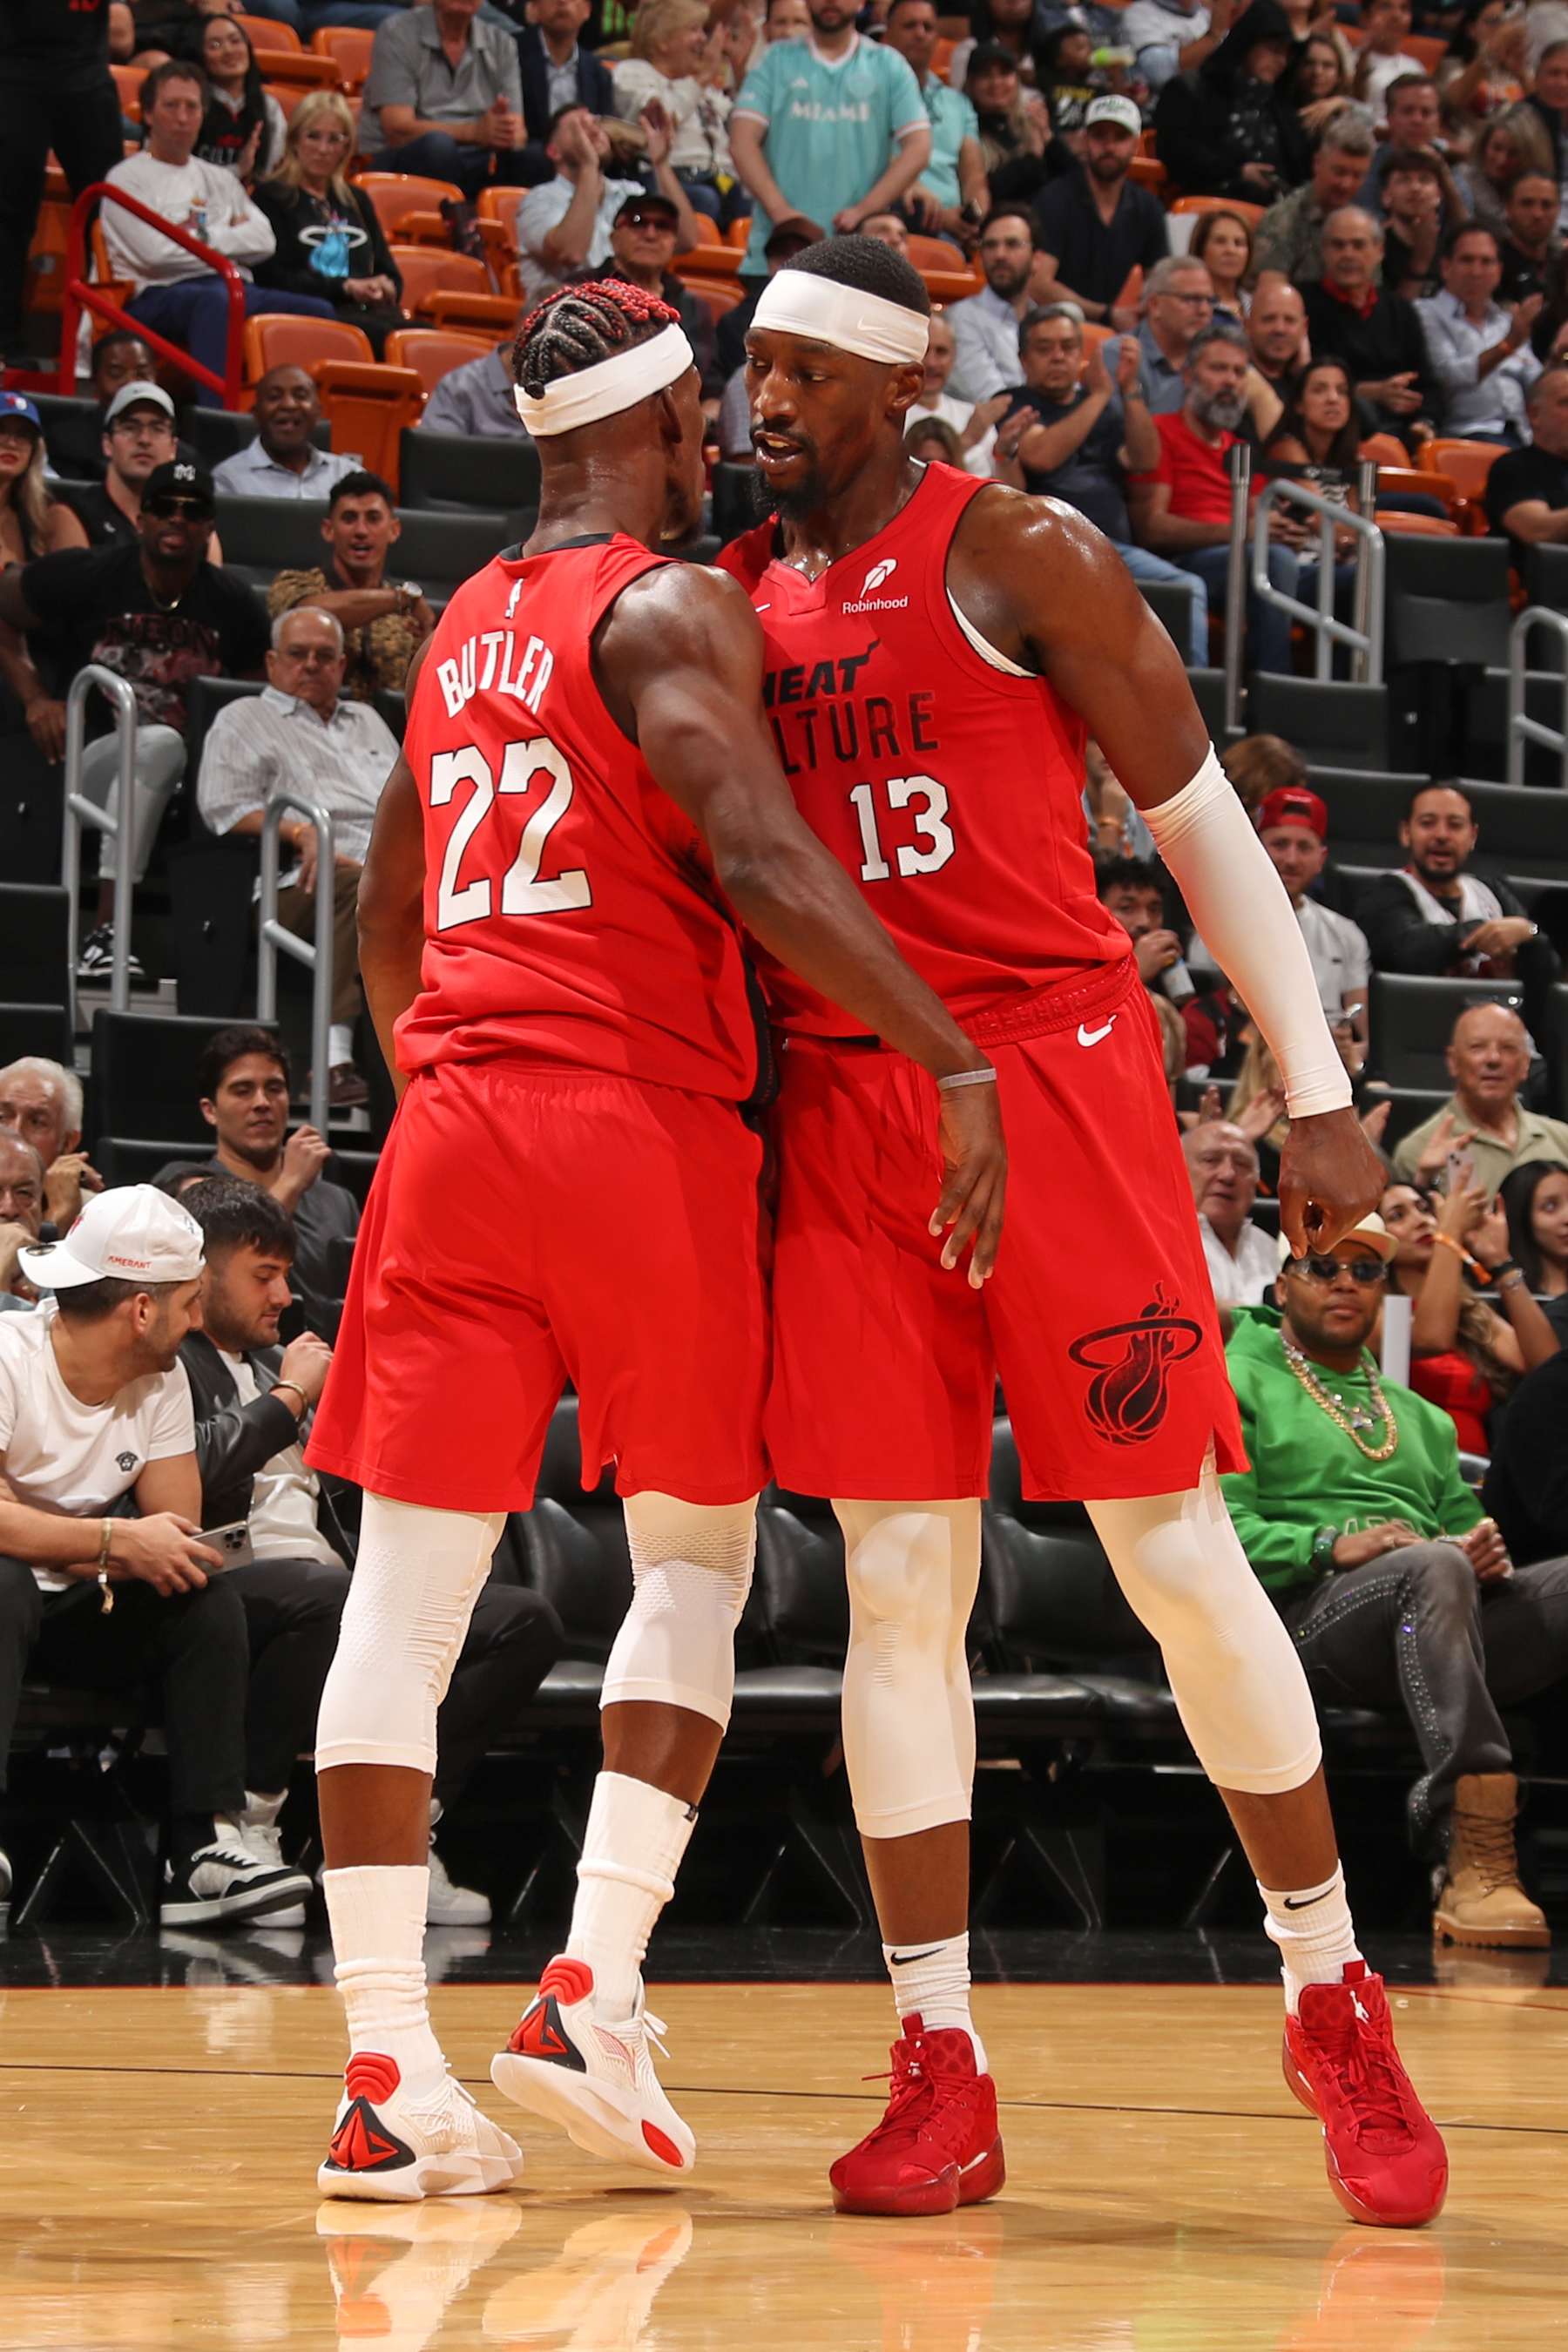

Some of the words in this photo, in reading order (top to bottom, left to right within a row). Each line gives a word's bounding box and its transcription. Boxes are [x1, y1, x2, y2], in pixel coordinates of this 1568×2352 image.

[789, 100, 870, 123] MIAMI
[842, 595, 909, 615] Robinhood
[436, 630, 555, 720] BUTLER
[772, 690, 939, 776] LTURE
[429, 735, 593, 933] 22
[848, 774, 956, 882] 13
